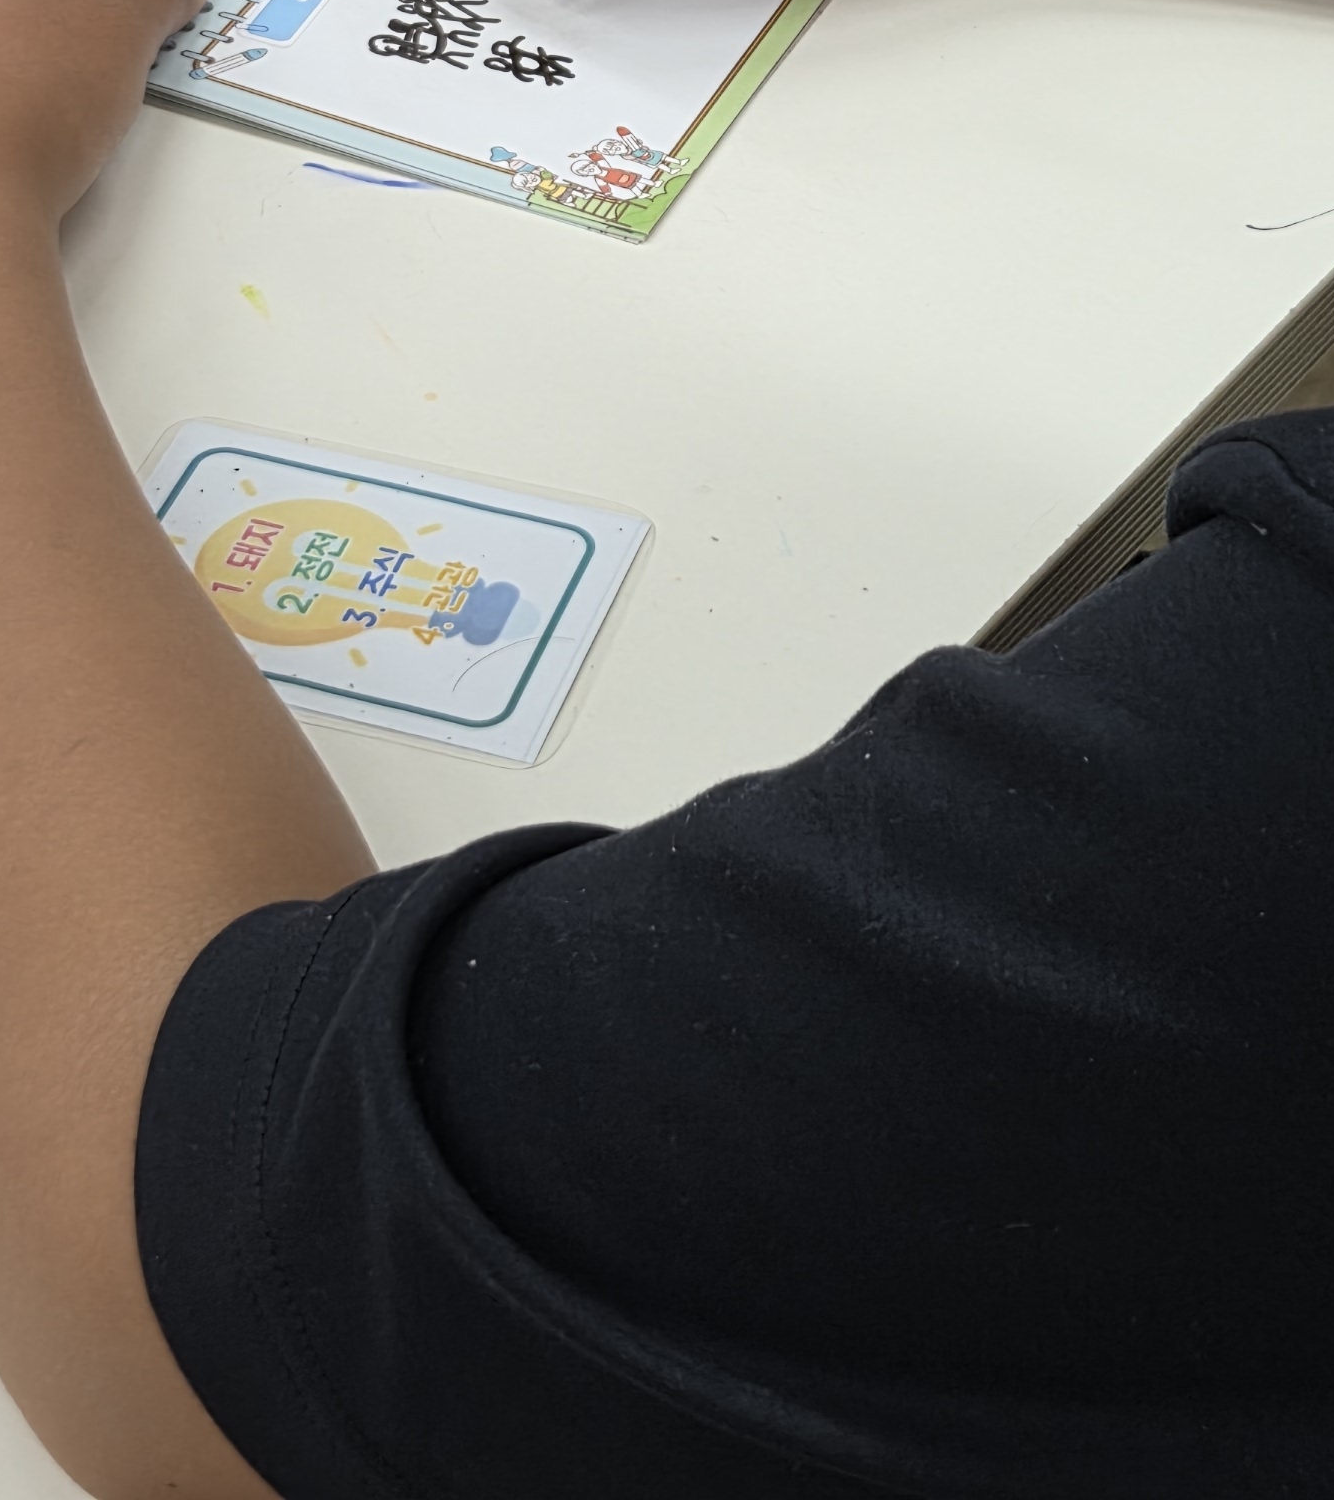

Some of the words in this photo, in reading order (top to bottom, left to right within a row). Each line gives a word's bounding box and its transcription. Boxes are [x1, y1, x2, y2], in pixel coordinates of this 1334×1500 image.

[225, 518, 285, 571] 돼지
[290, 531, 350, 581] 정전
[211, 580, 253, 594] 1.
[358, 546, 415, 597] 주식
[422, 560, 479, 614] 관광
[276, 592, 320, 615] 2.
[341, 607, 386, 628] 3.
[412, 621, 455, 645] 4.
